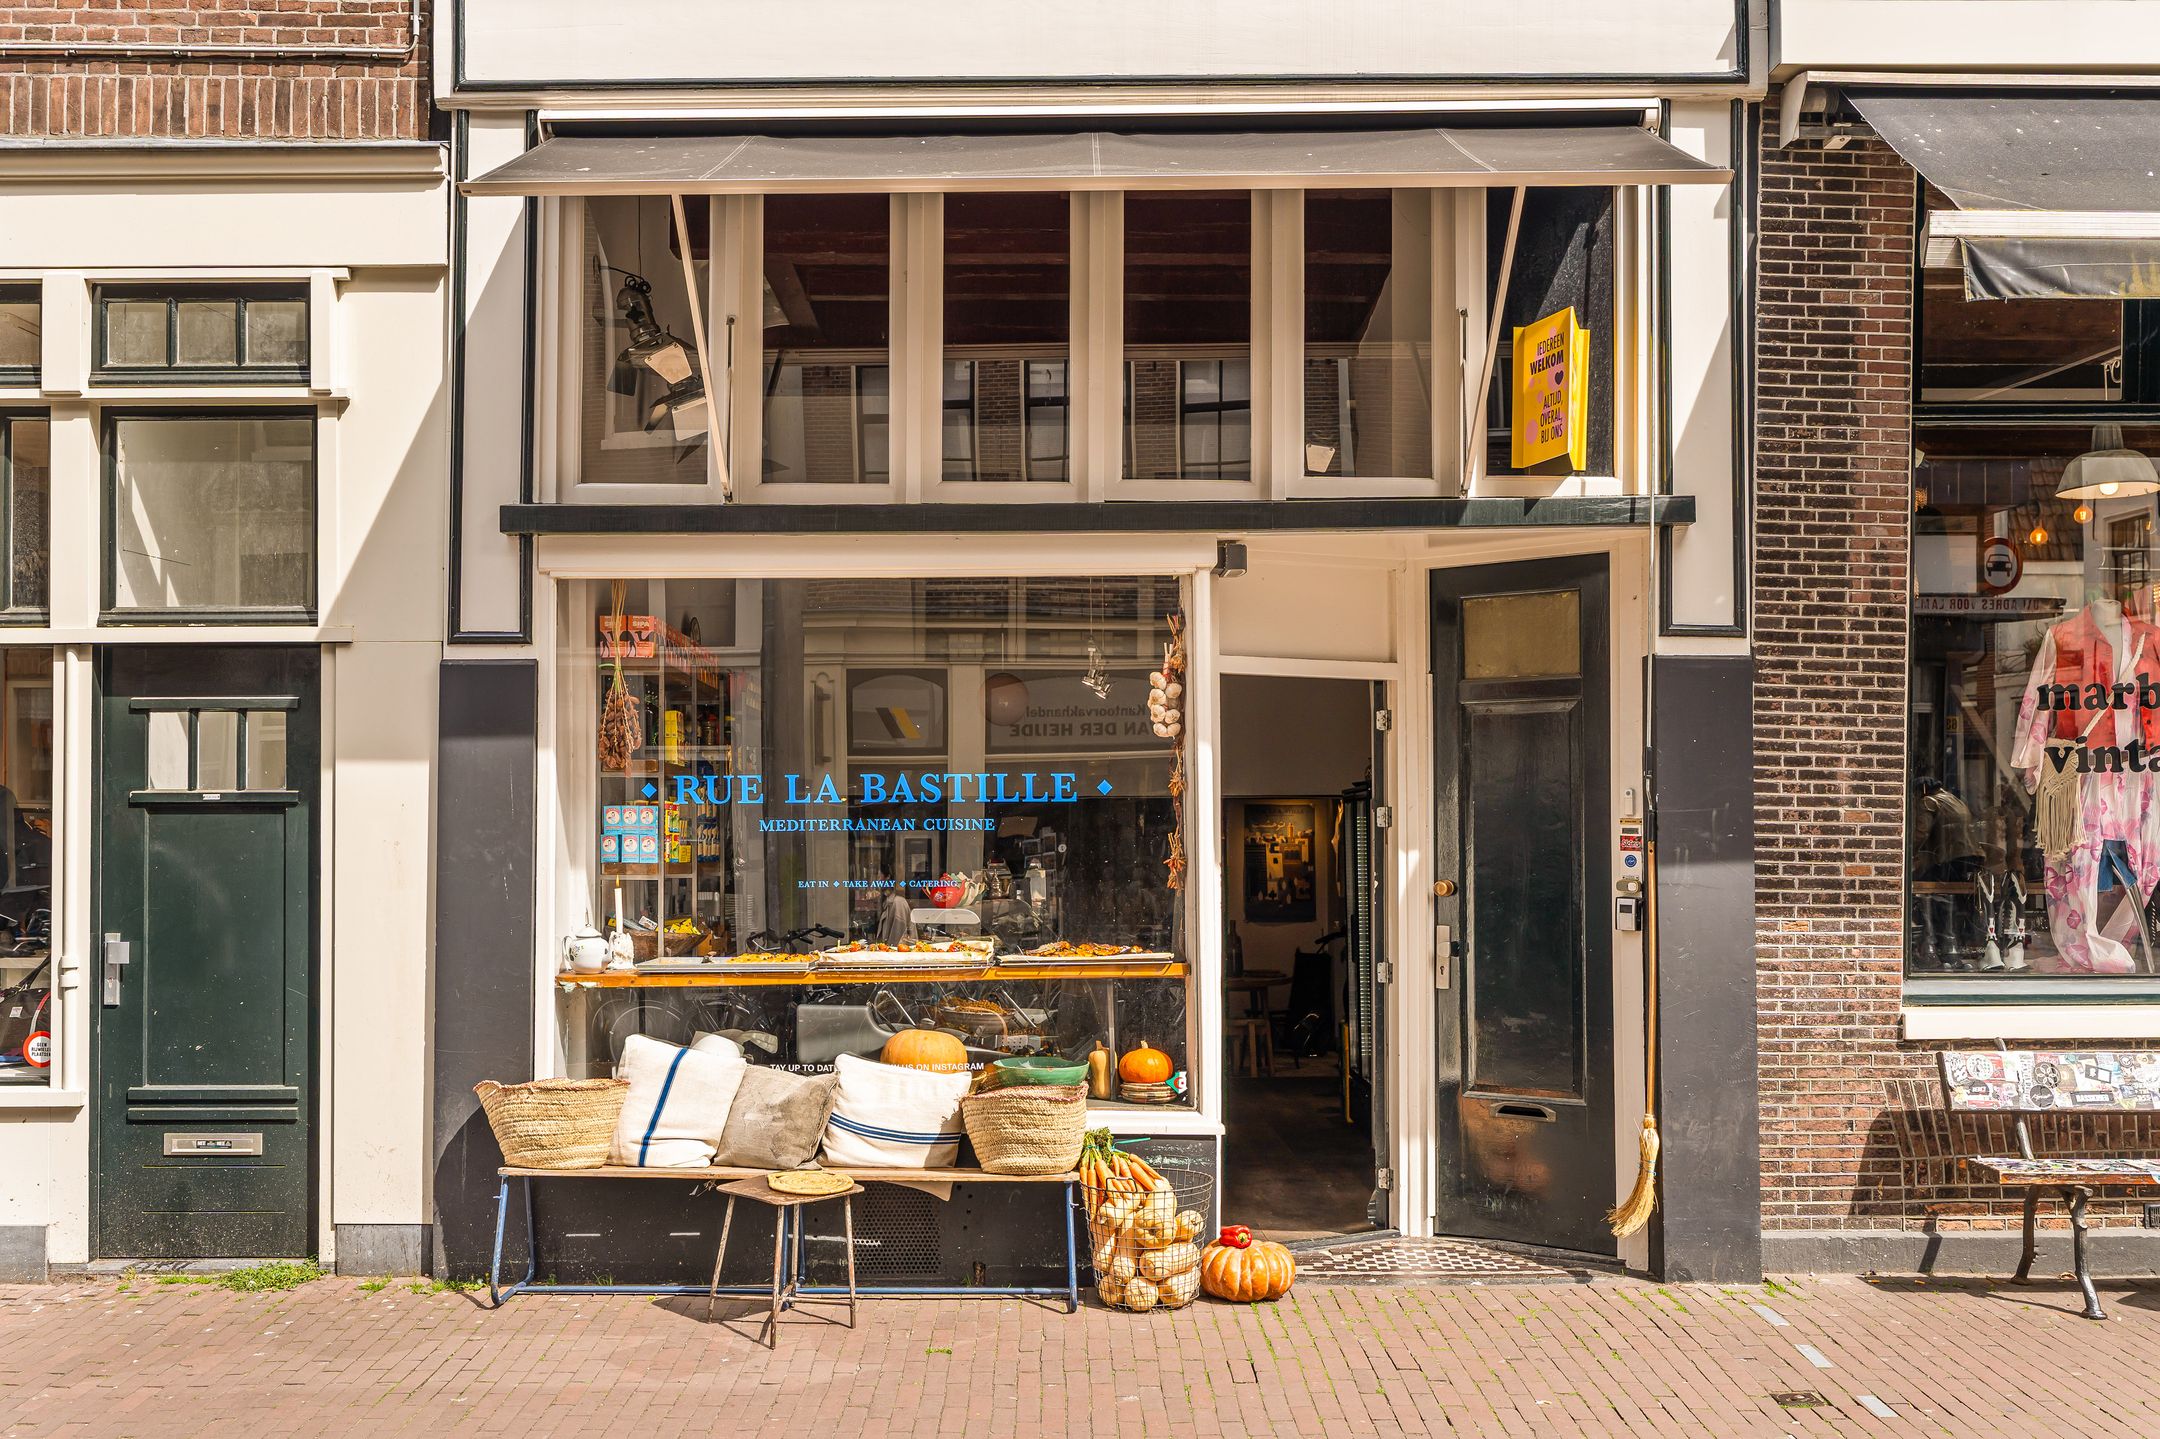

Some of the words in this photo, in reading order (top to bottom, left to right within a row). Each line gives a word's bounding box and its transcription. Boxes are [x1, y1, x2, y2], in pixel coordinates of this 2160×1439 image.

[1537, 332, 1565, 356] IEDEREEN
[1530, 350, 1564, 375] WELKOM
[1543, 390, 1563, 410] ALTIJD,
[1540, 407, 1563, 427] OVERAL,
[1540, 429, 1549, 444] BIJ
[1550, 424, 1563, 440] ONS
[2036, 672, 2160, 711] marb
[673, 774, 764, 805] RUE
[784, 774, 842, 804] LA
[860, 773, 1078, 804] BASTILLE
[759, 818, 916, 833] MEDITERRANEAN
[923, 817, 995, 831] CUISINE
[798, 880, 816, 888] EAT
[818, 880, 829, 888] IN
[842, 880, 868, 888] TAKE
[870, 880, 896, 888] AWAY
[909, 880, 958, 888] CATERING
[788, 1064, 800, 1072] UP
[801, 1064, 815, 1072] TO
[816, 1064, 834, 1072] DAT
[916, 1063, 929, 1071] ON
[932, 1062, 985, 1071] INSTAGRAM
